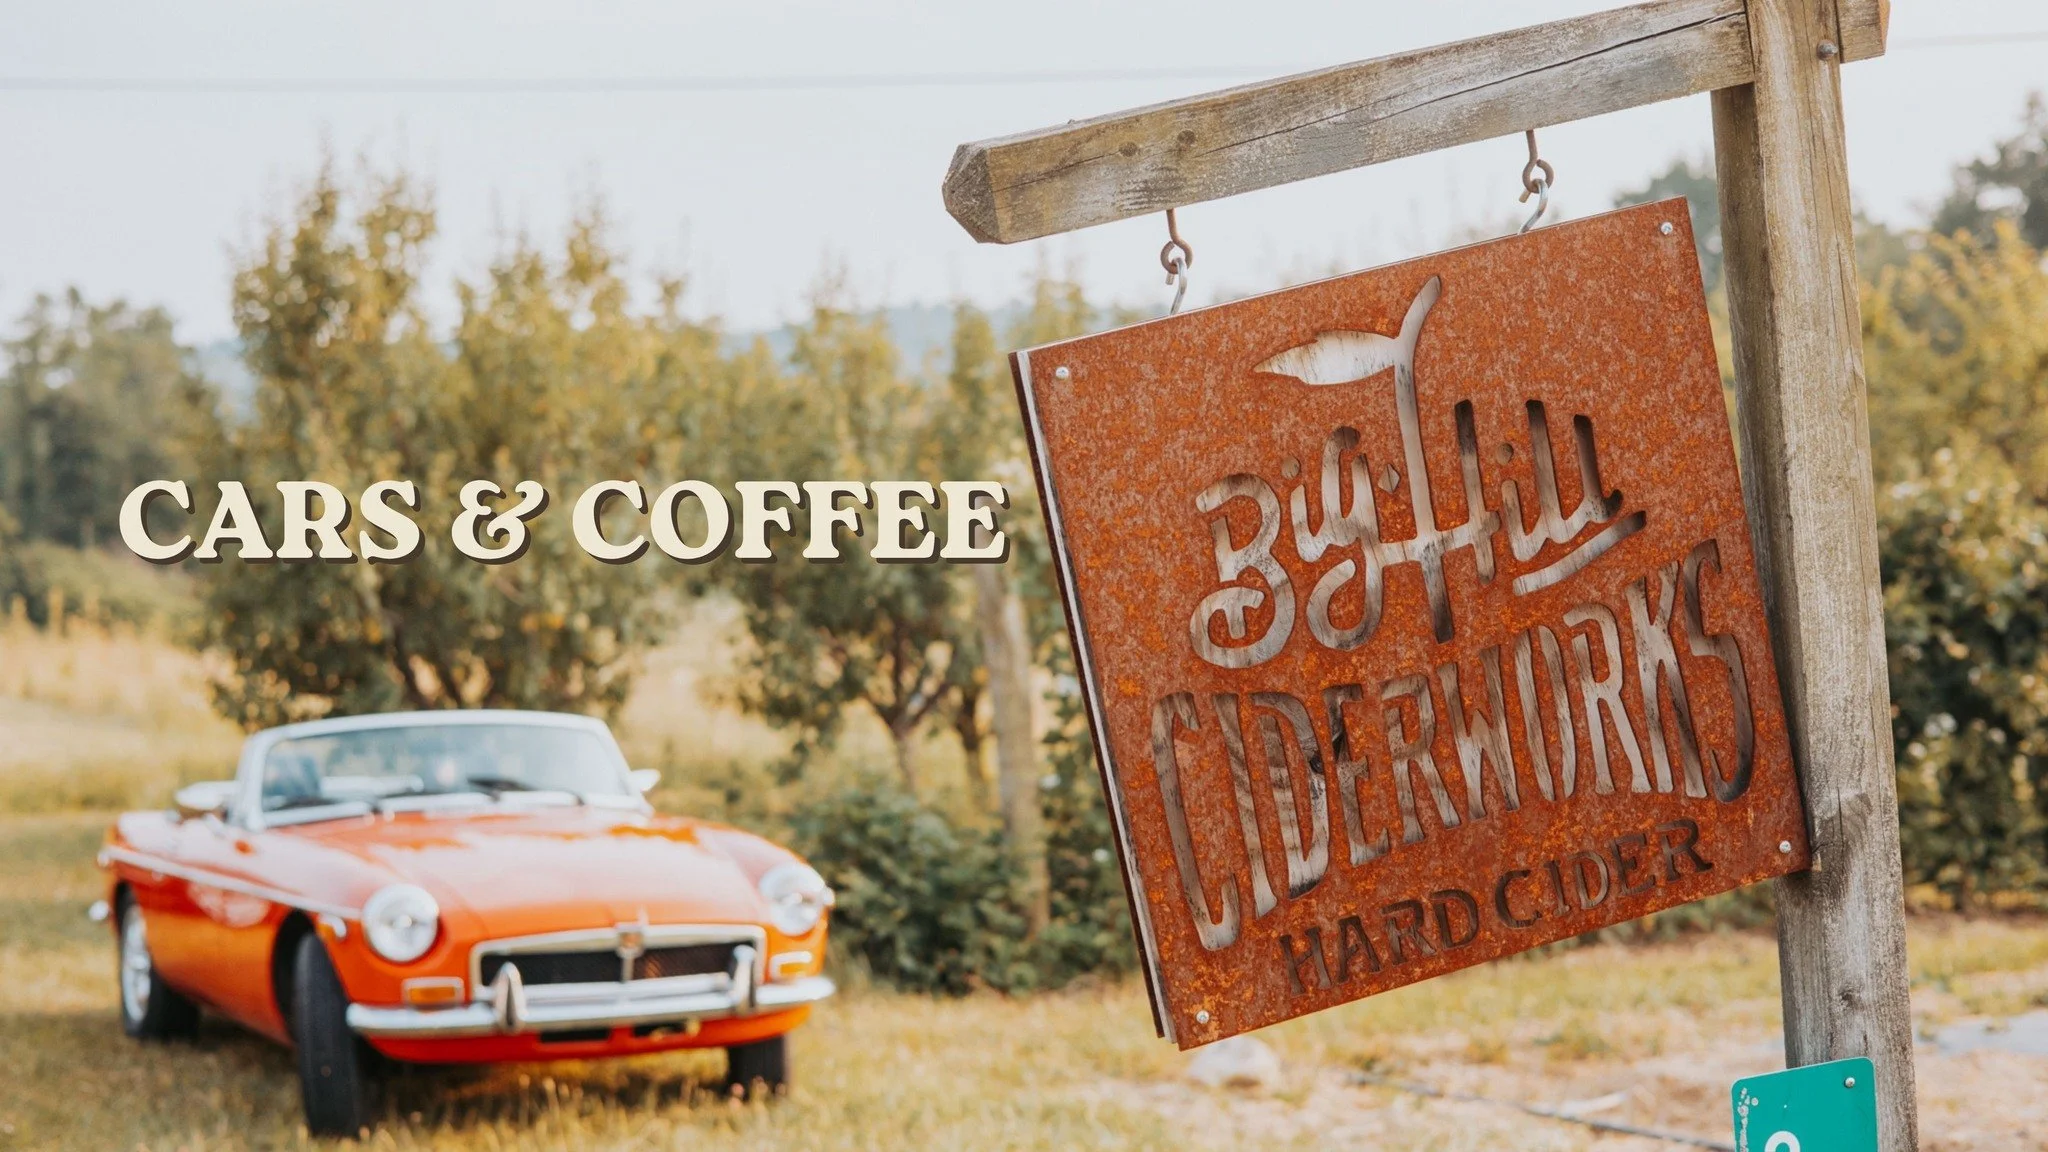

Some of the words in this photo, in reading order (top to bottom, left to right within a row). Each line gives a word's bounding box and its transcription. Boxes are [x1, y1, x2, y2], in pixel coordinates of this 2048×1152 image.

[1188, 425, 1384, 669] Big
[1384, 275, 1626, 643] Hill
[1151, 538, 1755, 951] CIDERWORKS
[1279, 891, 1479, 998] HARD
[1494, 818, 1713, 930] CIDER
